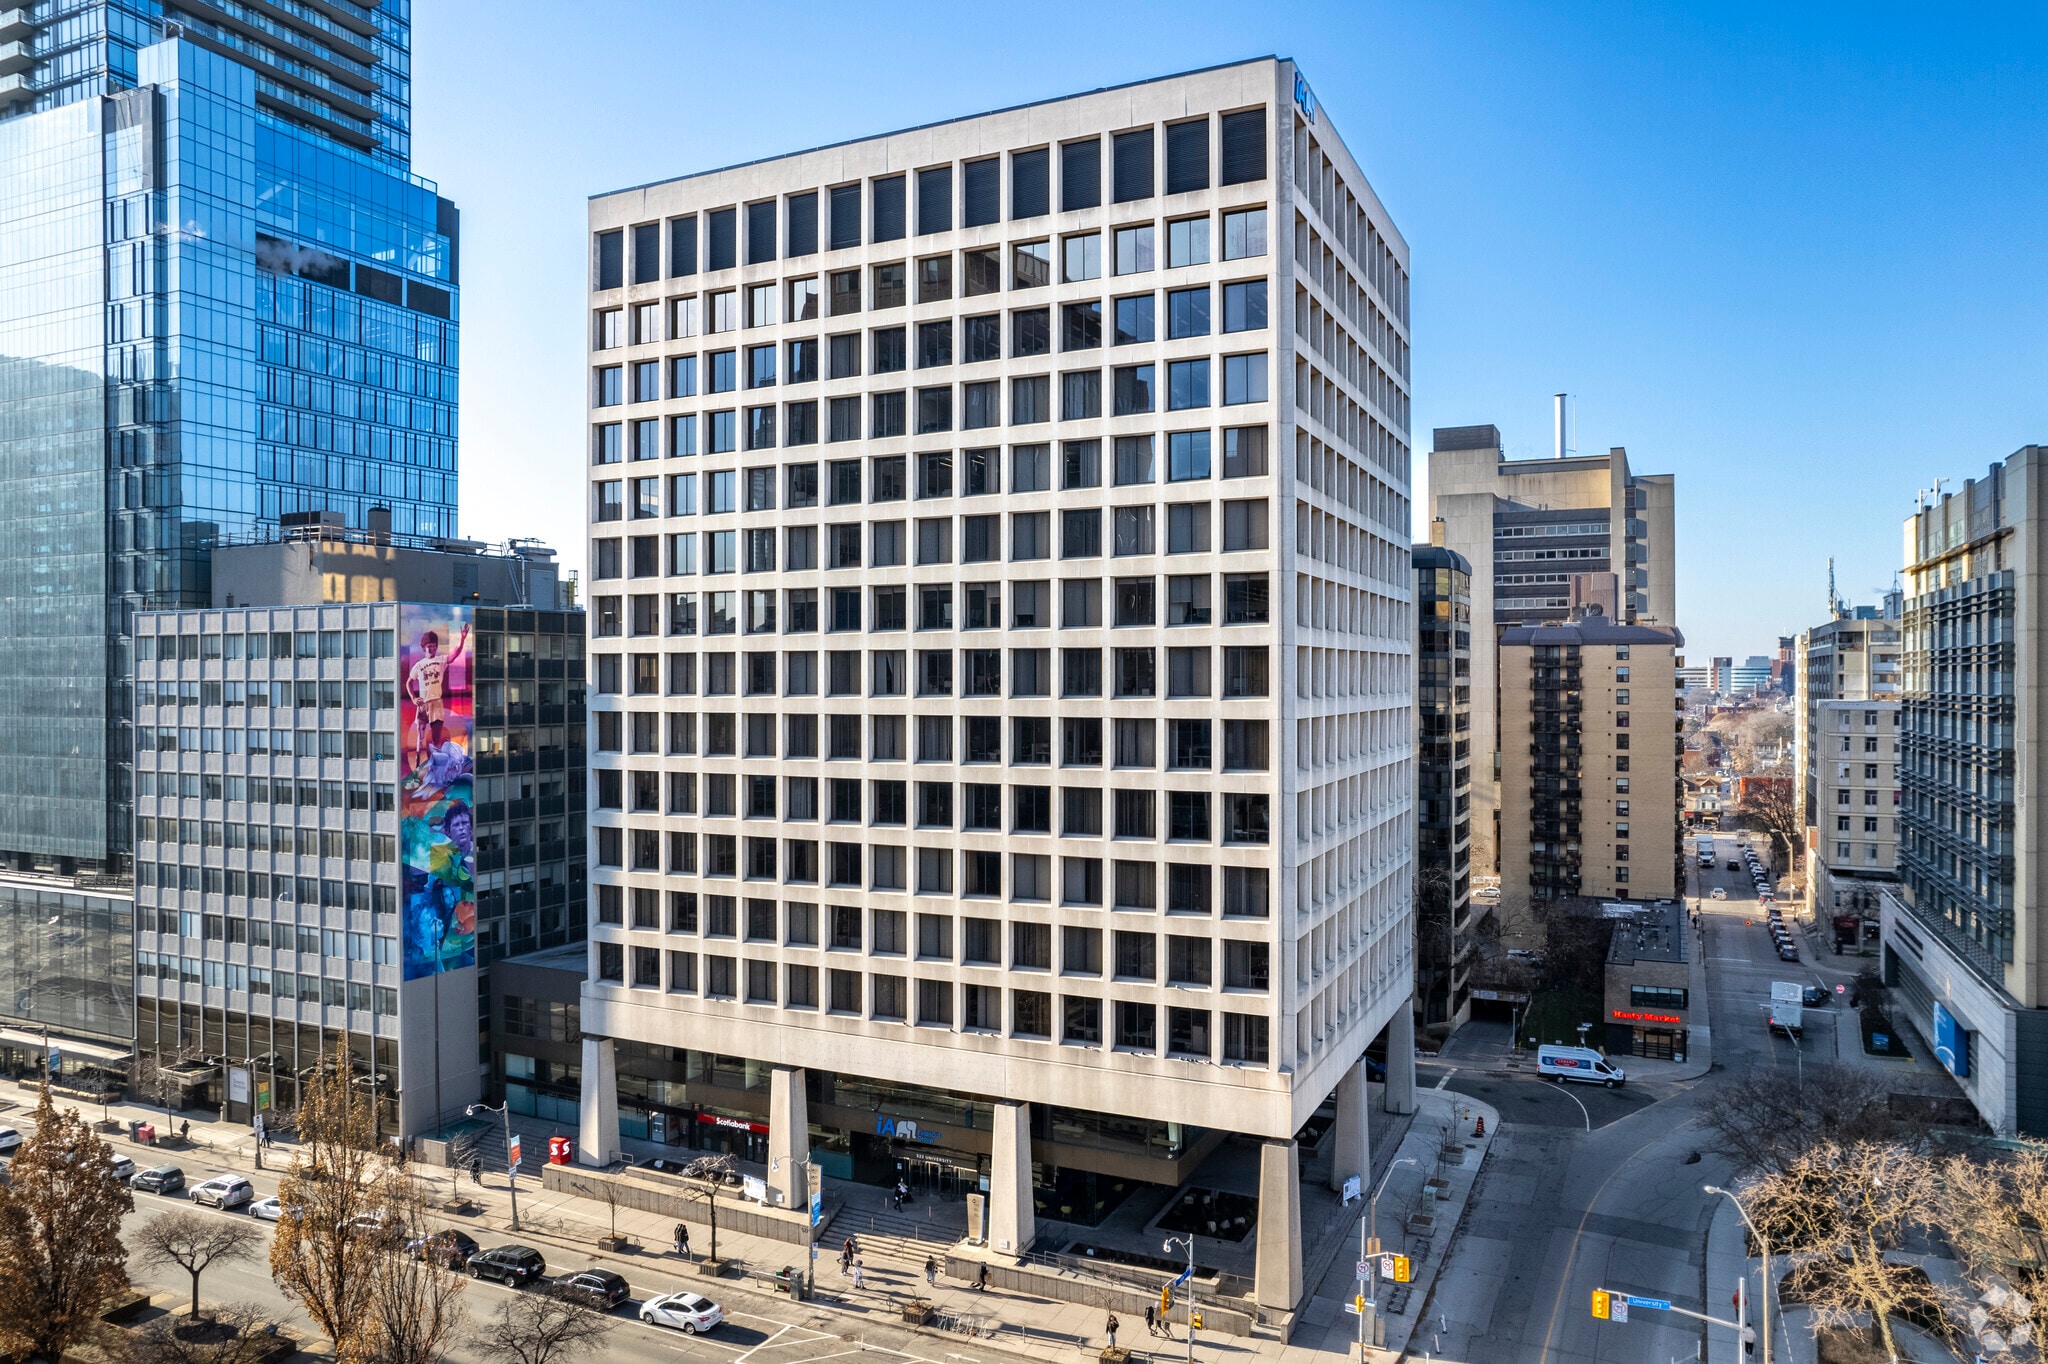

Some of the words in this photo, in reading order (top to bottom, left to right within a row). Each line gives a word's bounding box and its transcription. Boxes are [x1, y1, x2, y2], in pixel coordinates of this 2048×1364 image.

[1613, 1010, 1642, 1020] Hasty
[1643, 1013, 1680, 1023] Market
[716, 1117, 750, 1130] Scotiabank
[925, 1155, 952, 1164] UNIVERSITY
[1633, 1298, 1662, 1308] University
